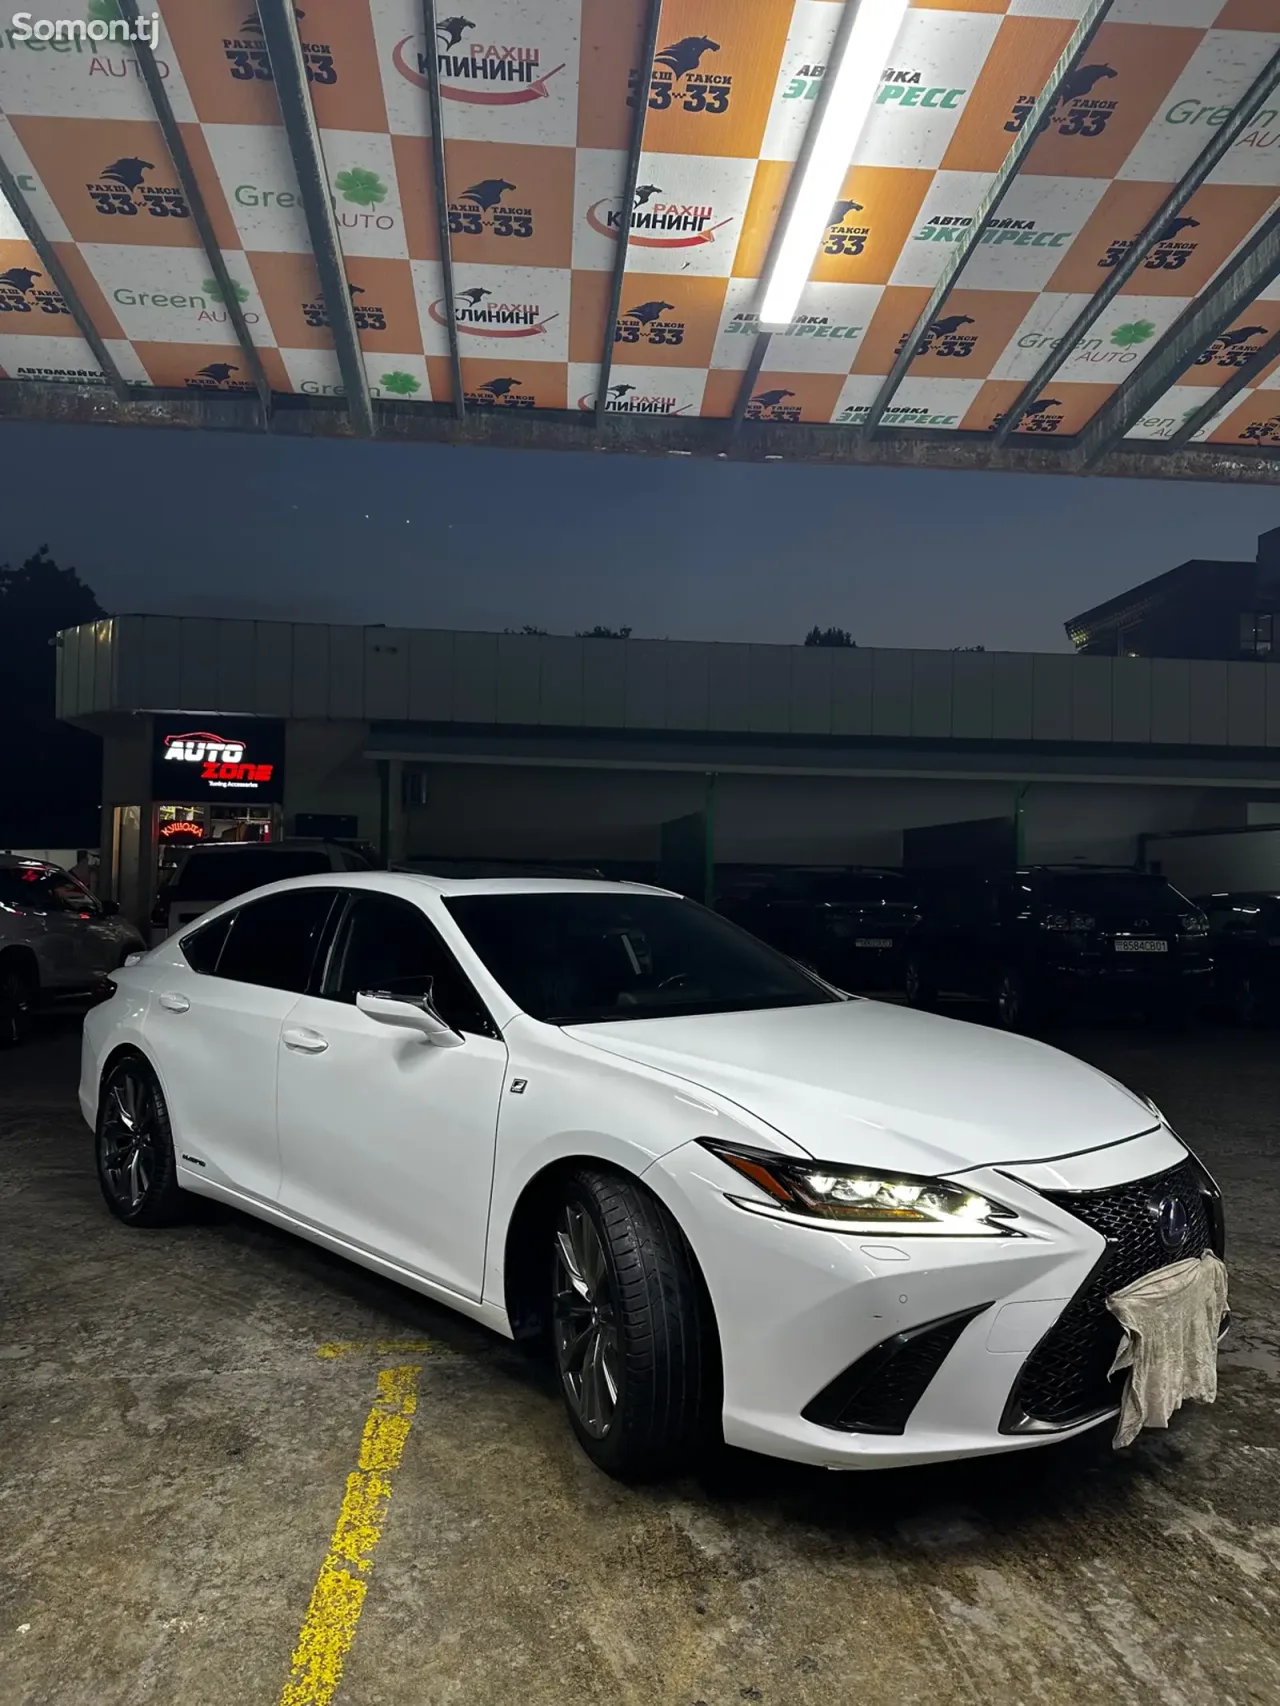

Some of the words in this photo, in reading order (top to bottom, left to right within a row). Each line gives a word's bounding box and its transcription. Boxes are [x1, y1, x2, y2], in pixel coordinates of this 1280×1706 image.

[302, 43, 331, 54] КСИ
[470, 44, 540, 62] РАХШ
[685, 73, 733, 85] ТАКСИ
[796, 65, 922, 84] АВЙКА
[683, 83, 731, 113] 33
[1072, 99, 1118, 109] ТАКСИ
[1165, 98, 1278, 129] Gren
[1058, 109, 1113, 136] 33
[85, 184, 128, 193] РАХШ
[137, 186, 181, 195] ТАКСИ
[89, 192, 137, 215] 33
[143, 195, 190, 218] 33
[448, 204, 480, 212] АХШ
[491, 207, 532, 215] ТАКСИ
[653, 203, 713, 217] РАХШ
[494, 215, 533, 237] 33
[928, 216, 1036, 230] АВТООЙКА
[830, 227, 870, 235] ТАКСИ
[824, 235, 867, 255] 33
[1159, 242, 1199, 250] ТАКСИ
[1144, 250, 1192, 269] 33
[113, 288, 207, 309] Green
[487, 303, 540, 315] РАХШ
[197, 310, 259, 324] AUO
[456, 308, 540, 325] ЛИНИНГ
[650, 321, 686, 329] ТАКСИ
[648, 328, 685, 345] 33
[936, 341, 975, 357] 33
[1075, 351, 1137, 363] AUTO
[630, 396, 677, 404] РАХШ
[604, 401, 676, 414] ЛИНИНГ
[164, 741, 244, 763] AUTO
